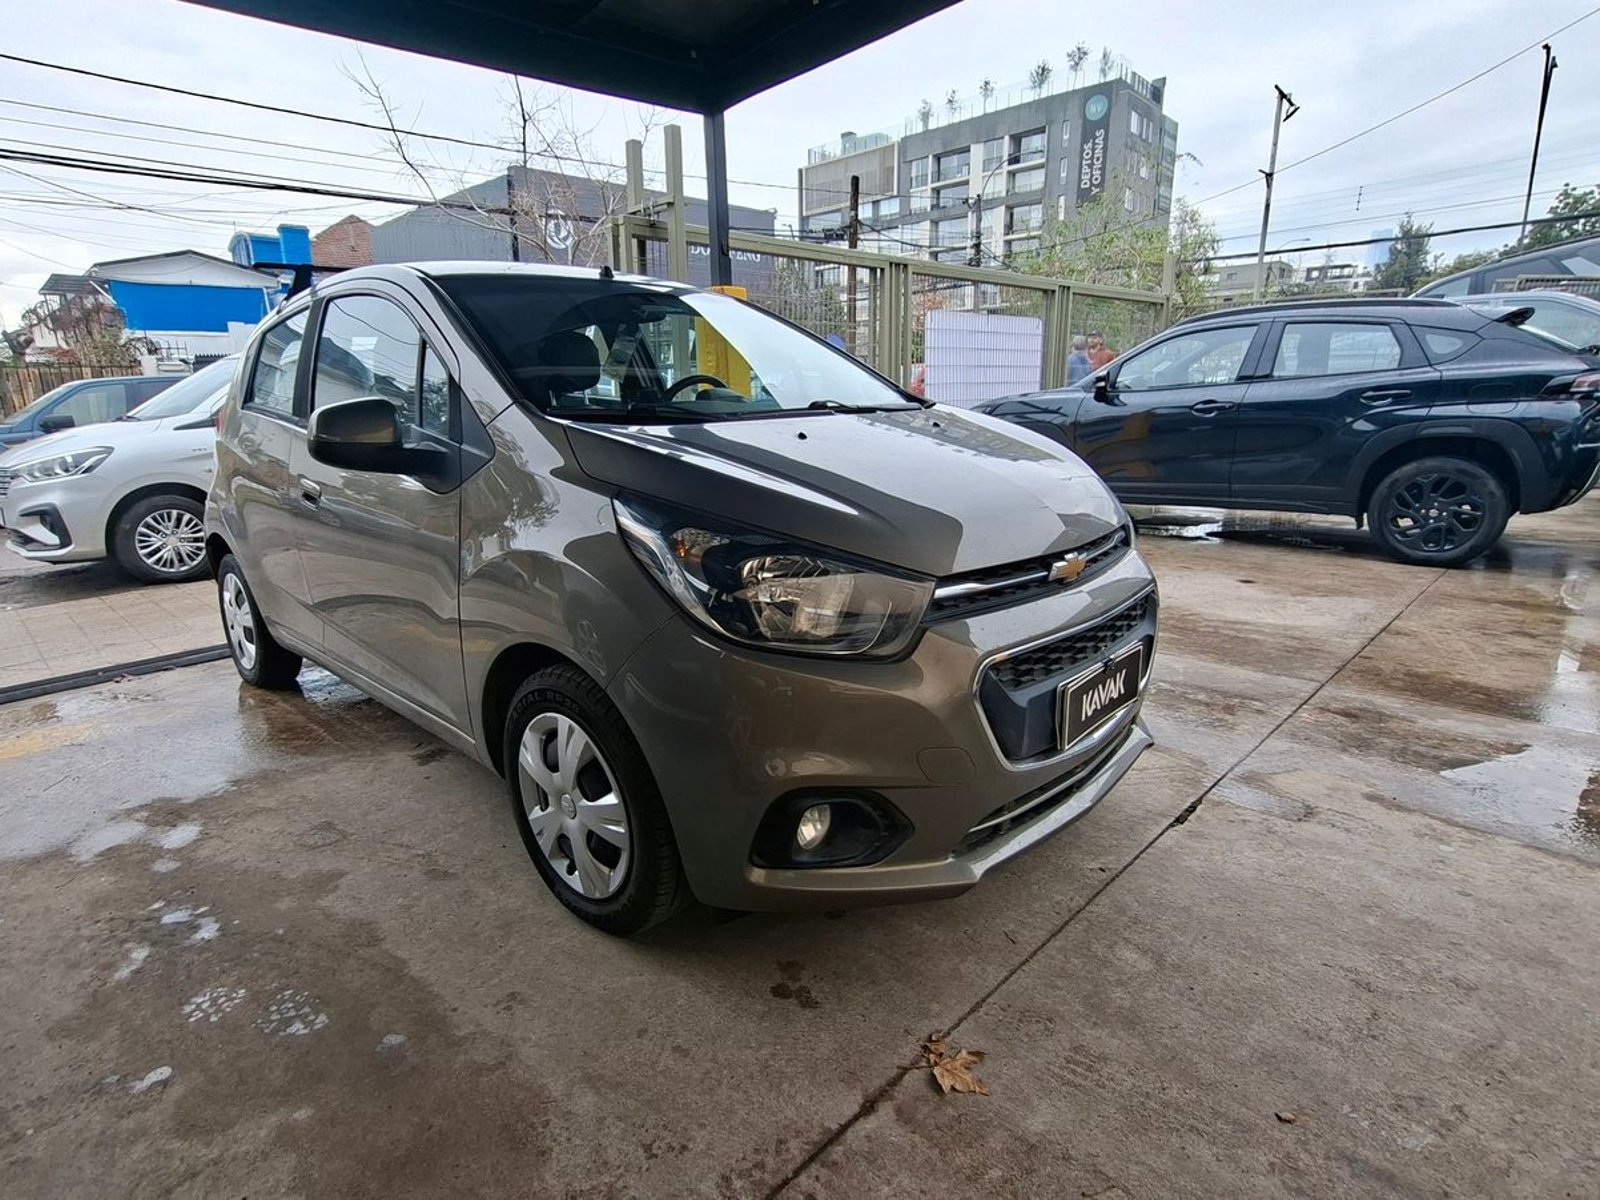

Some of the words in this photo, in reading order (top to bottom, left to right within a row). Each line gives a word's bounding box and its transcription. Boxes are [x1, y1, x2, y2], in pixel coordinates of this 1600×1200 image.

[1080, 139, 1094, 189] DEPTOS.
[1092, 128, 1105, 185] OFICINAS
[1091, 187, 1100, 196] Y
[1081, 668, 1127, 722] KAVAK
